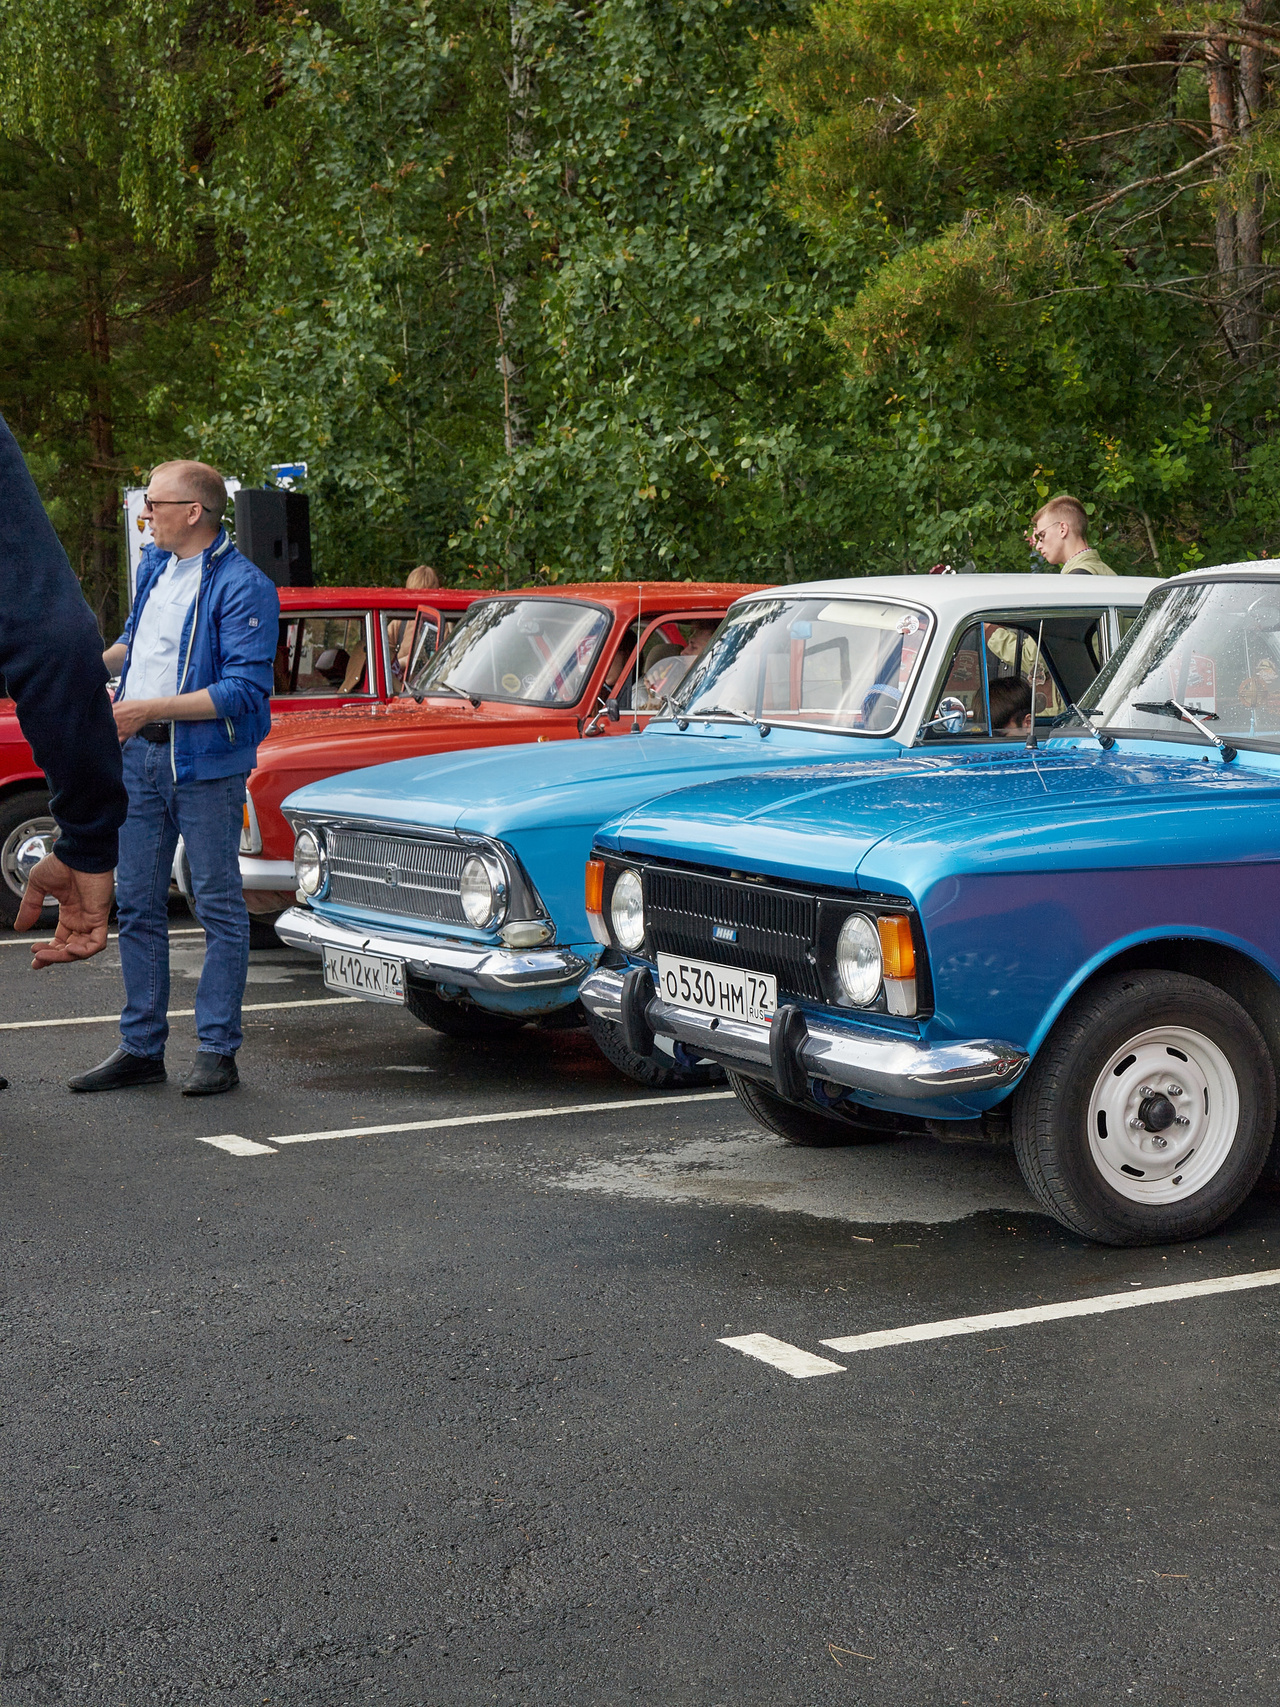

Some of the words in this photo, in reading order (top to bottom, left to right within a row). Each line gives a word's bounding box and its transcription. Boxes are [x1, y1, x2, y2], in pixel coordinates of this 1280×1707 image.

[383, 962, 400, 986] 72
[747, 976, 768, 1009] 72
[749, 1007, 764, 1021] RUS
